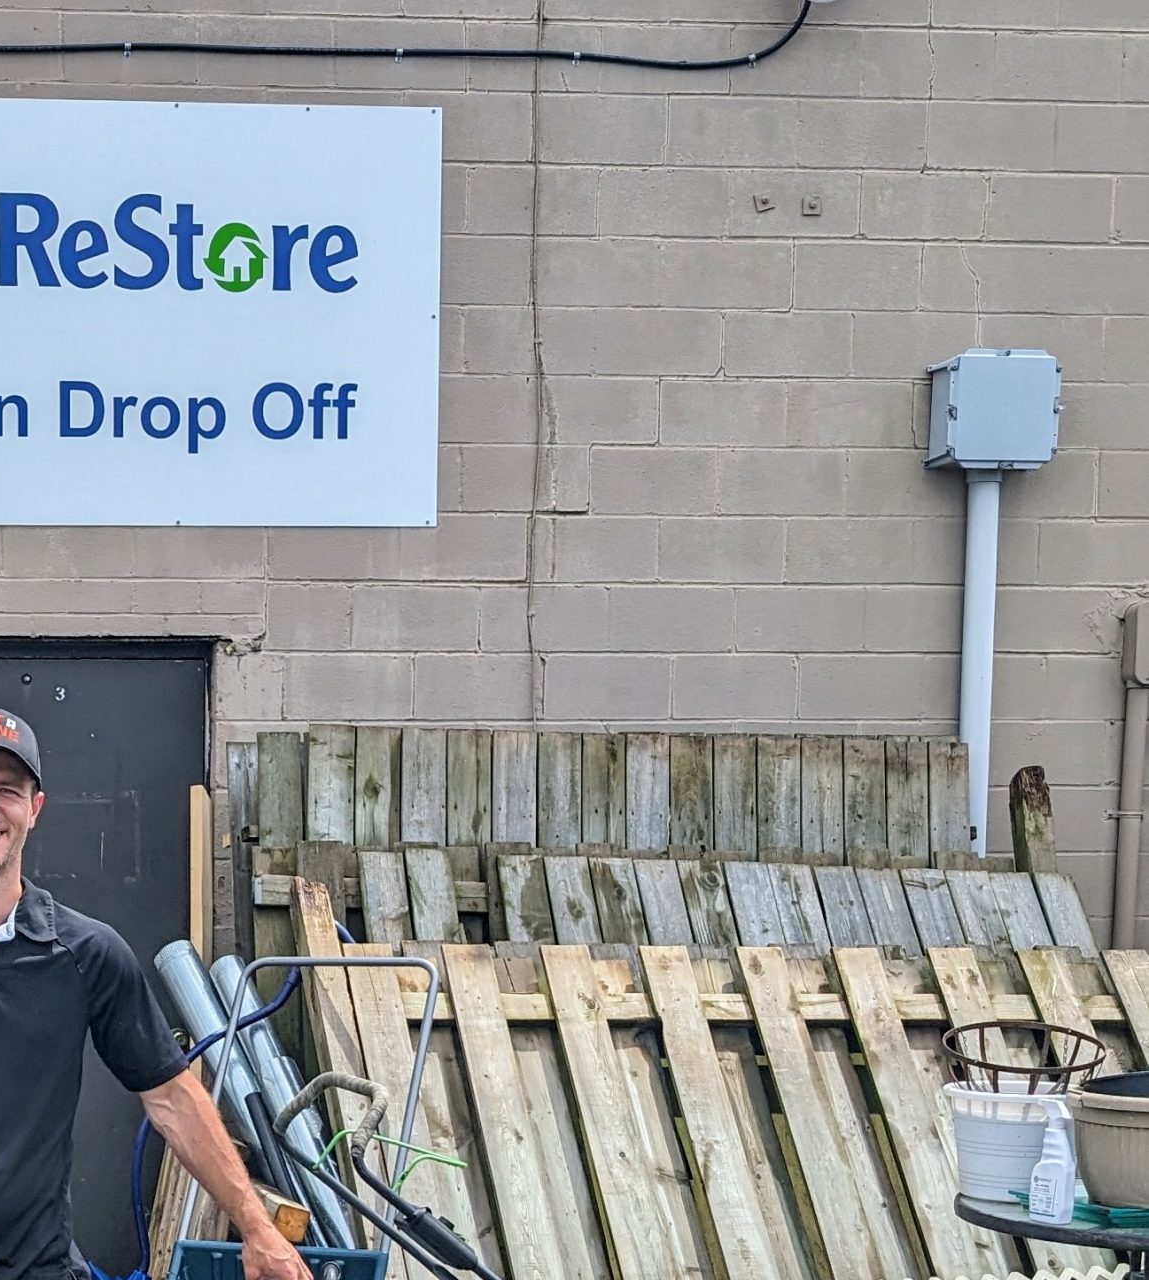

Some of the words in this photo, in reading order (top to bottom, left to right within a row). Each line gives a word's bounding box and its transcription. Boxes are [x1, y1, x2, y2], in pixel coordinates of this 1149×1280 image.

[60, 381, 227, 454] Drop
[253, 382, 359, 440] Off
[55, 686, 66, 701] 3
